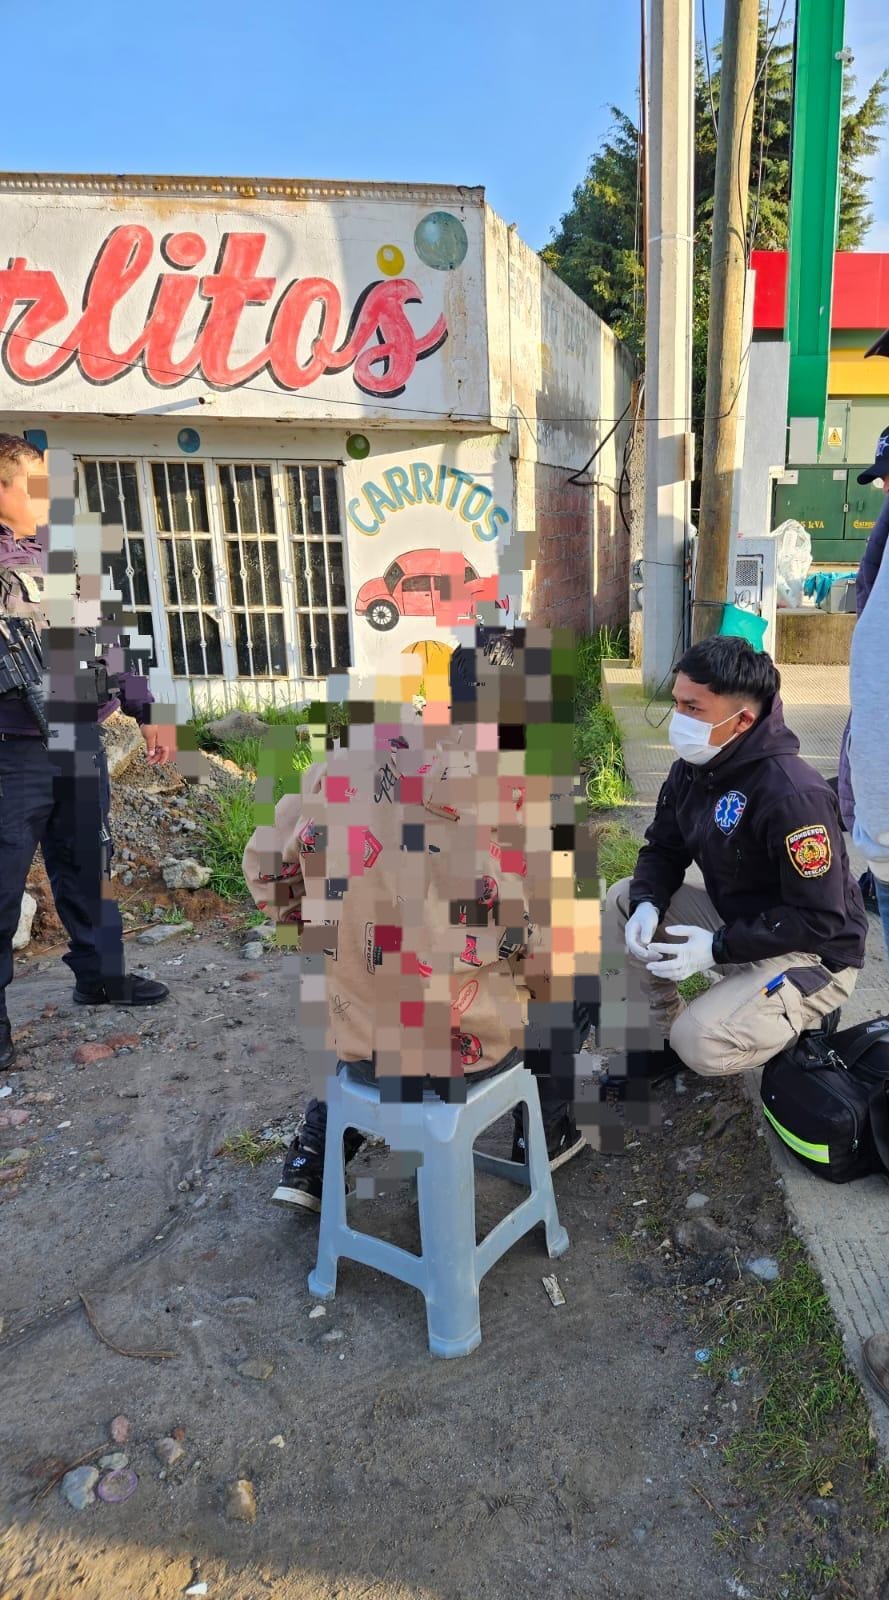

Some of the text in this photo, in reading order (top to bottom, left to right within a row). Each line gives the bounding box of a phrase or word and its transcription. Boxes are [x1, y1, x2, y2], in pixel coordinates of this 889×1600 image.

[347, 462, 510, 542] CARRITOS
[808, 520, 825, 529] kVA
[789, 828, 824, 844] BOMBEROS
